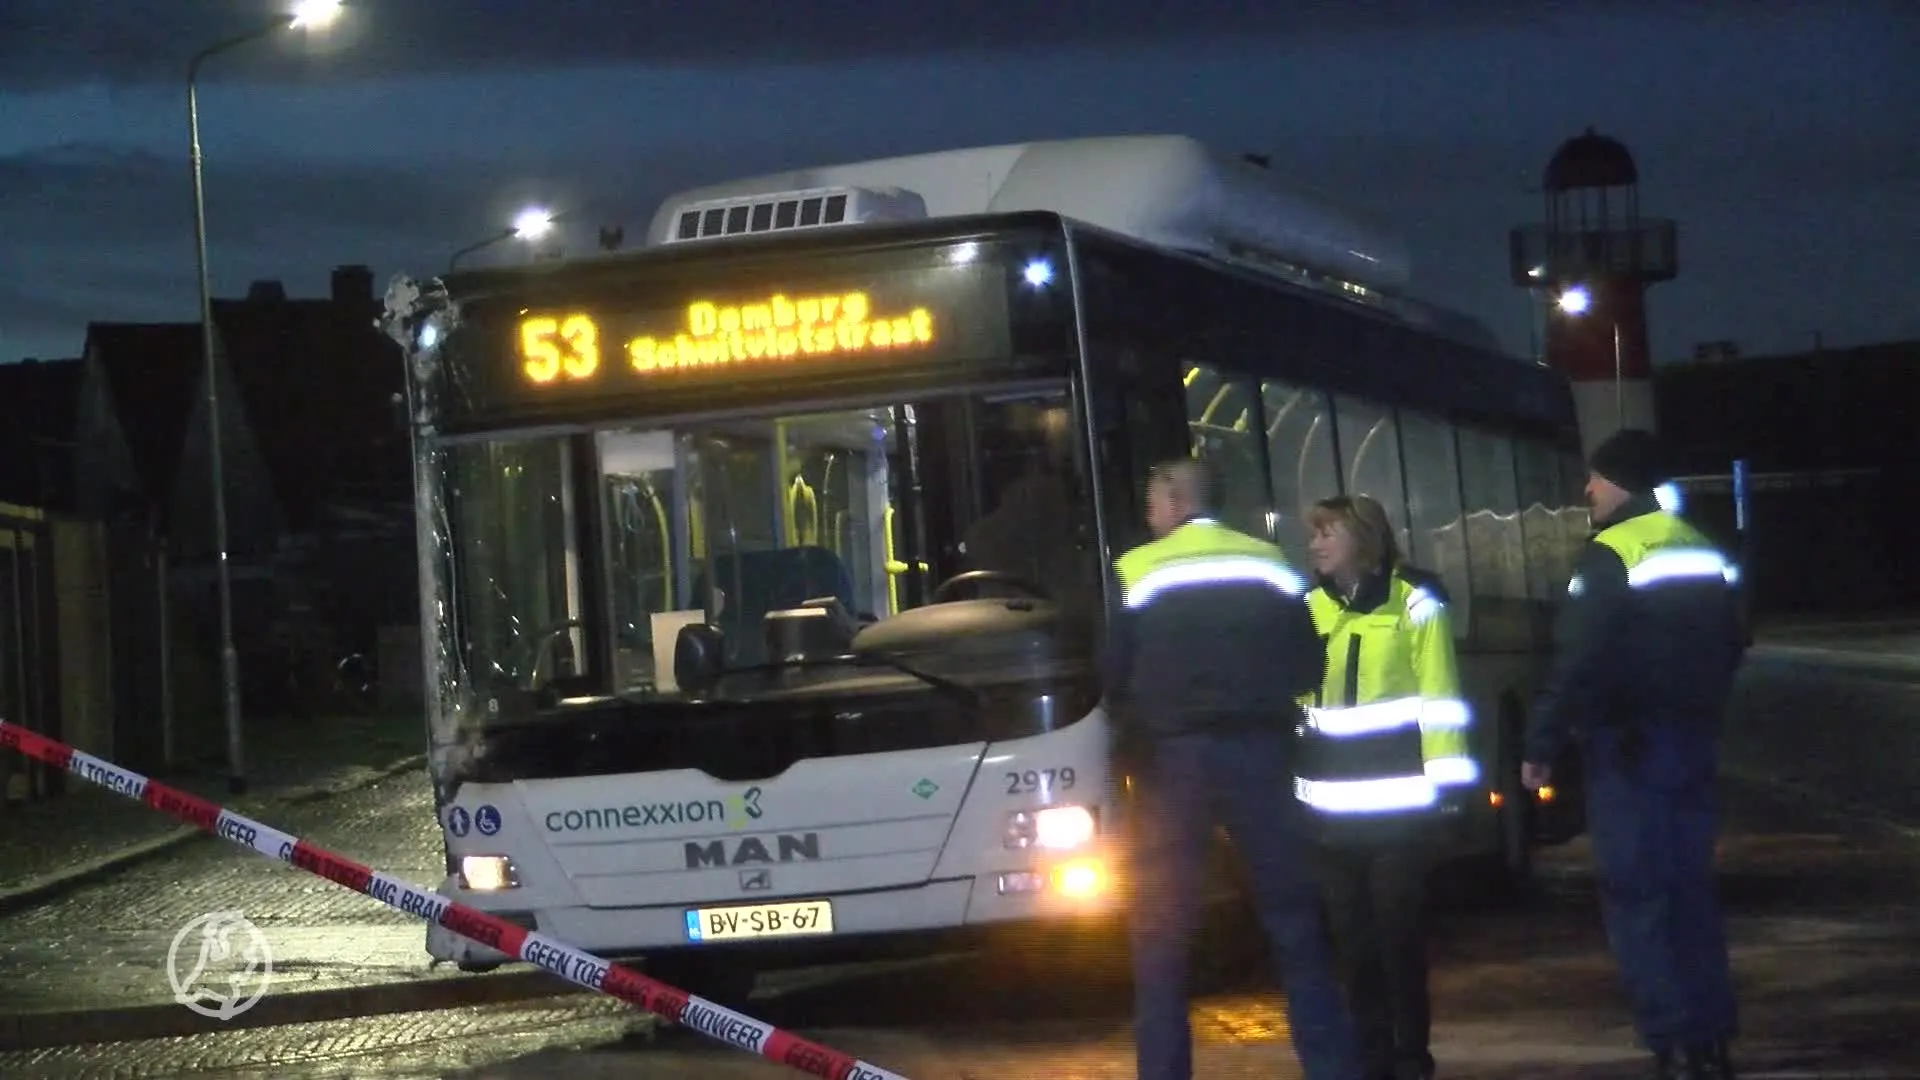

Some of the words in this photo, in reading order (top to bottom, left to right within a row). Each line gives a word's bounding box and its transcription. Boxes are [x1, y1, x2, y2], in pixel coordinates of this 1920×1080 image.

[690, 293, 868, 335] Domburg
[521, 314, 599, 382] 53
[1006, 767, 1075, 794] 2979
[546, 799, 724, 832] connexxion
[684, 832, 820, 868] MAN
[710, 907, 819, 934] BV-SB-67
[525, 941, 571, 975] GEEN
